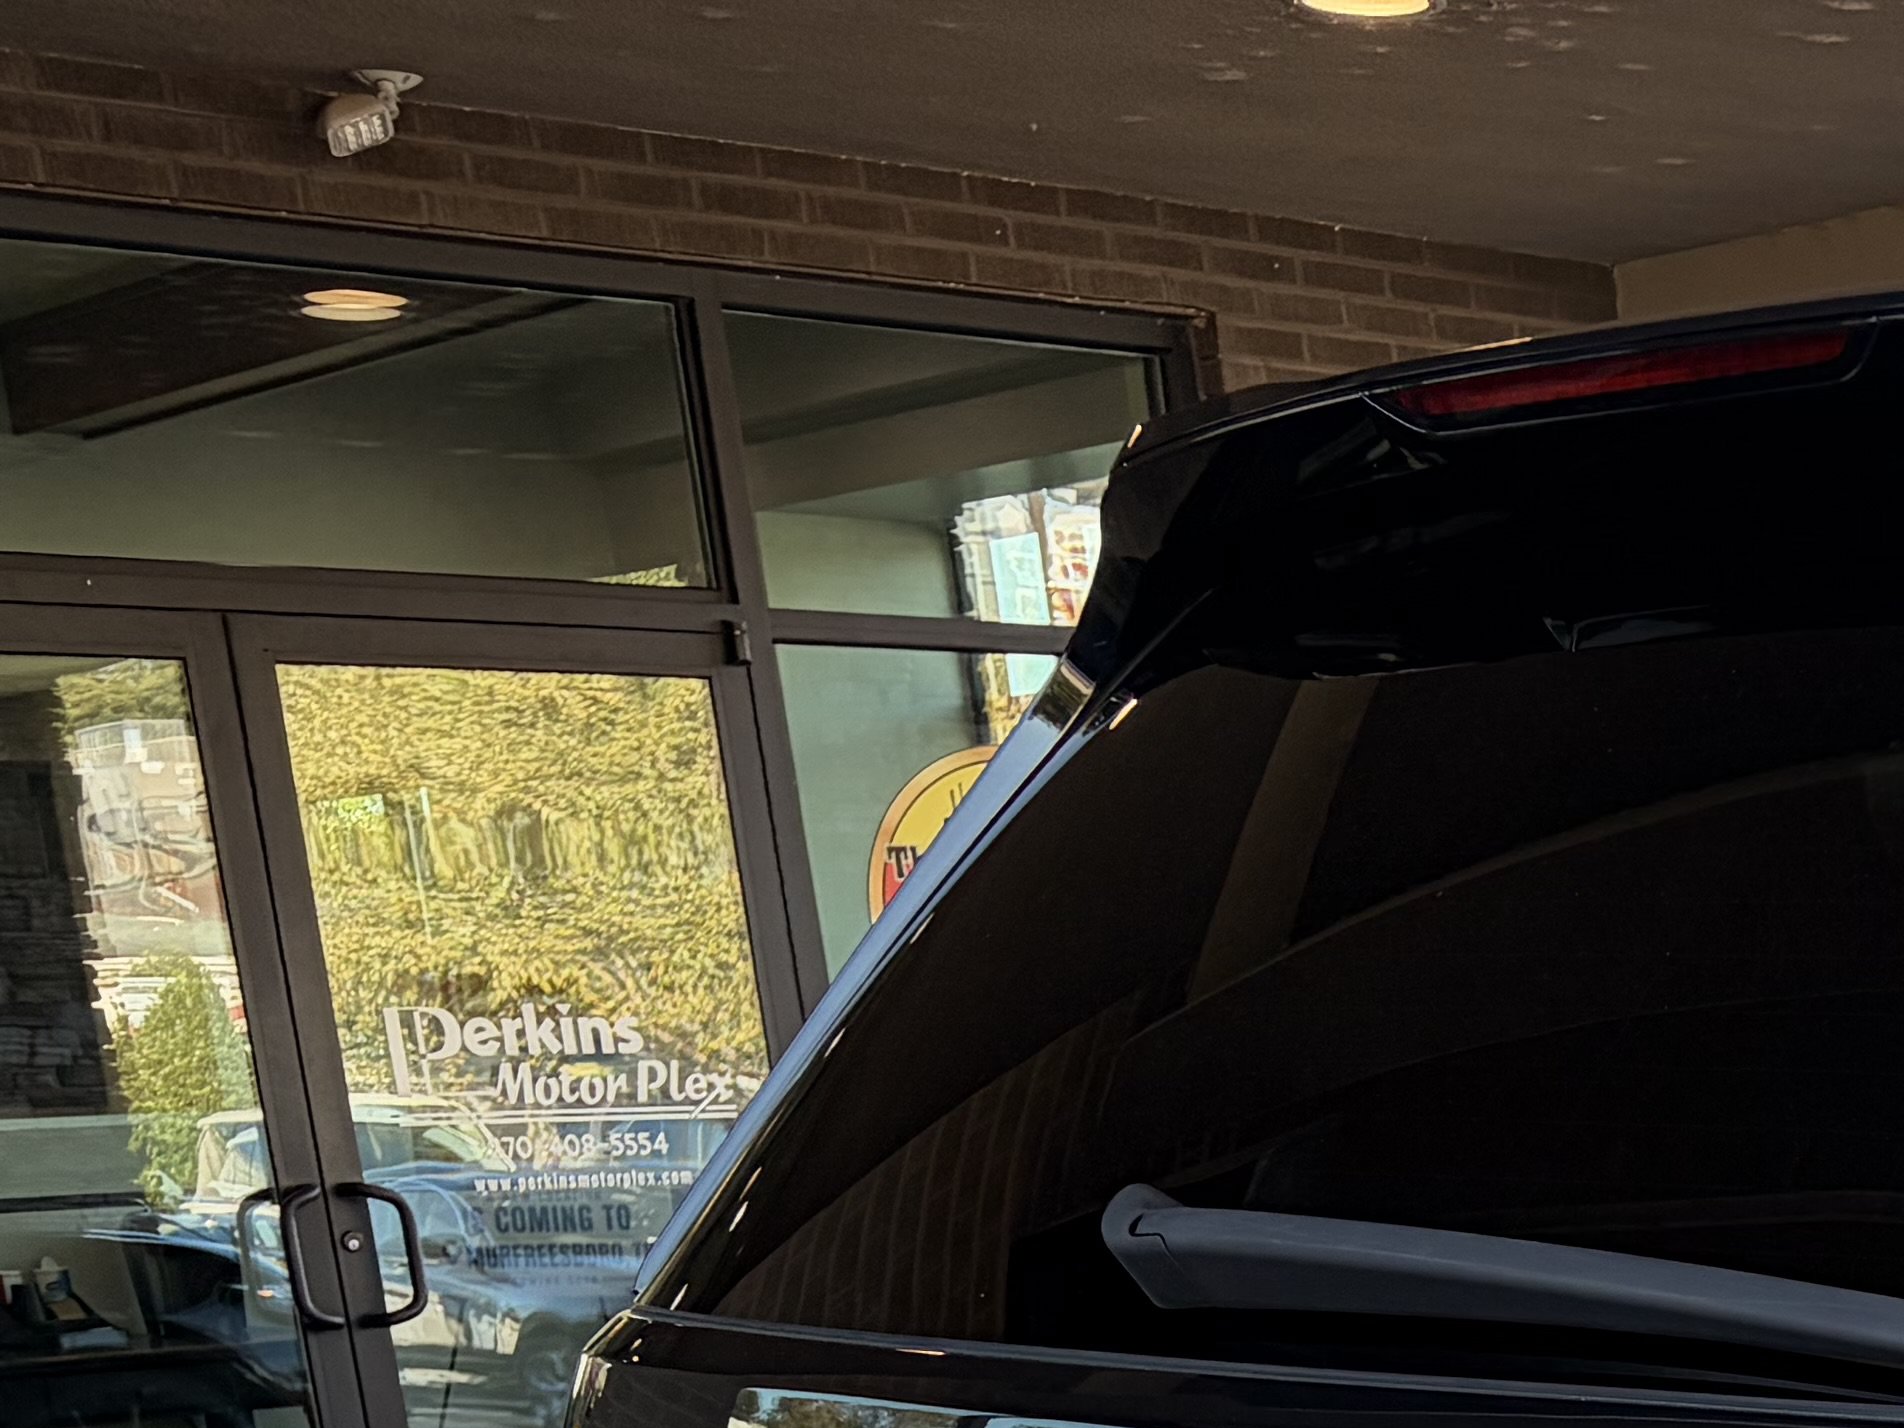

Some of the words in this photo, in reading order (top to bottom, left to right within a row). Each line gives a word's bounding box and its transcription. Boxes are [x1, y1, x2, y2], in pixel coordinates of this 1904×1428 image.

[383, 1002, 644, 1098] Perkins
[497, 1061, 626, 1107] Motor
[637, 1058, 735, 1119] Plex
[474, 1168, 693, 1193] www.perkinsmotorplex.com
[495, 1205, 593, 1233] COMING
[601, 1203, 631, 1231] TO
